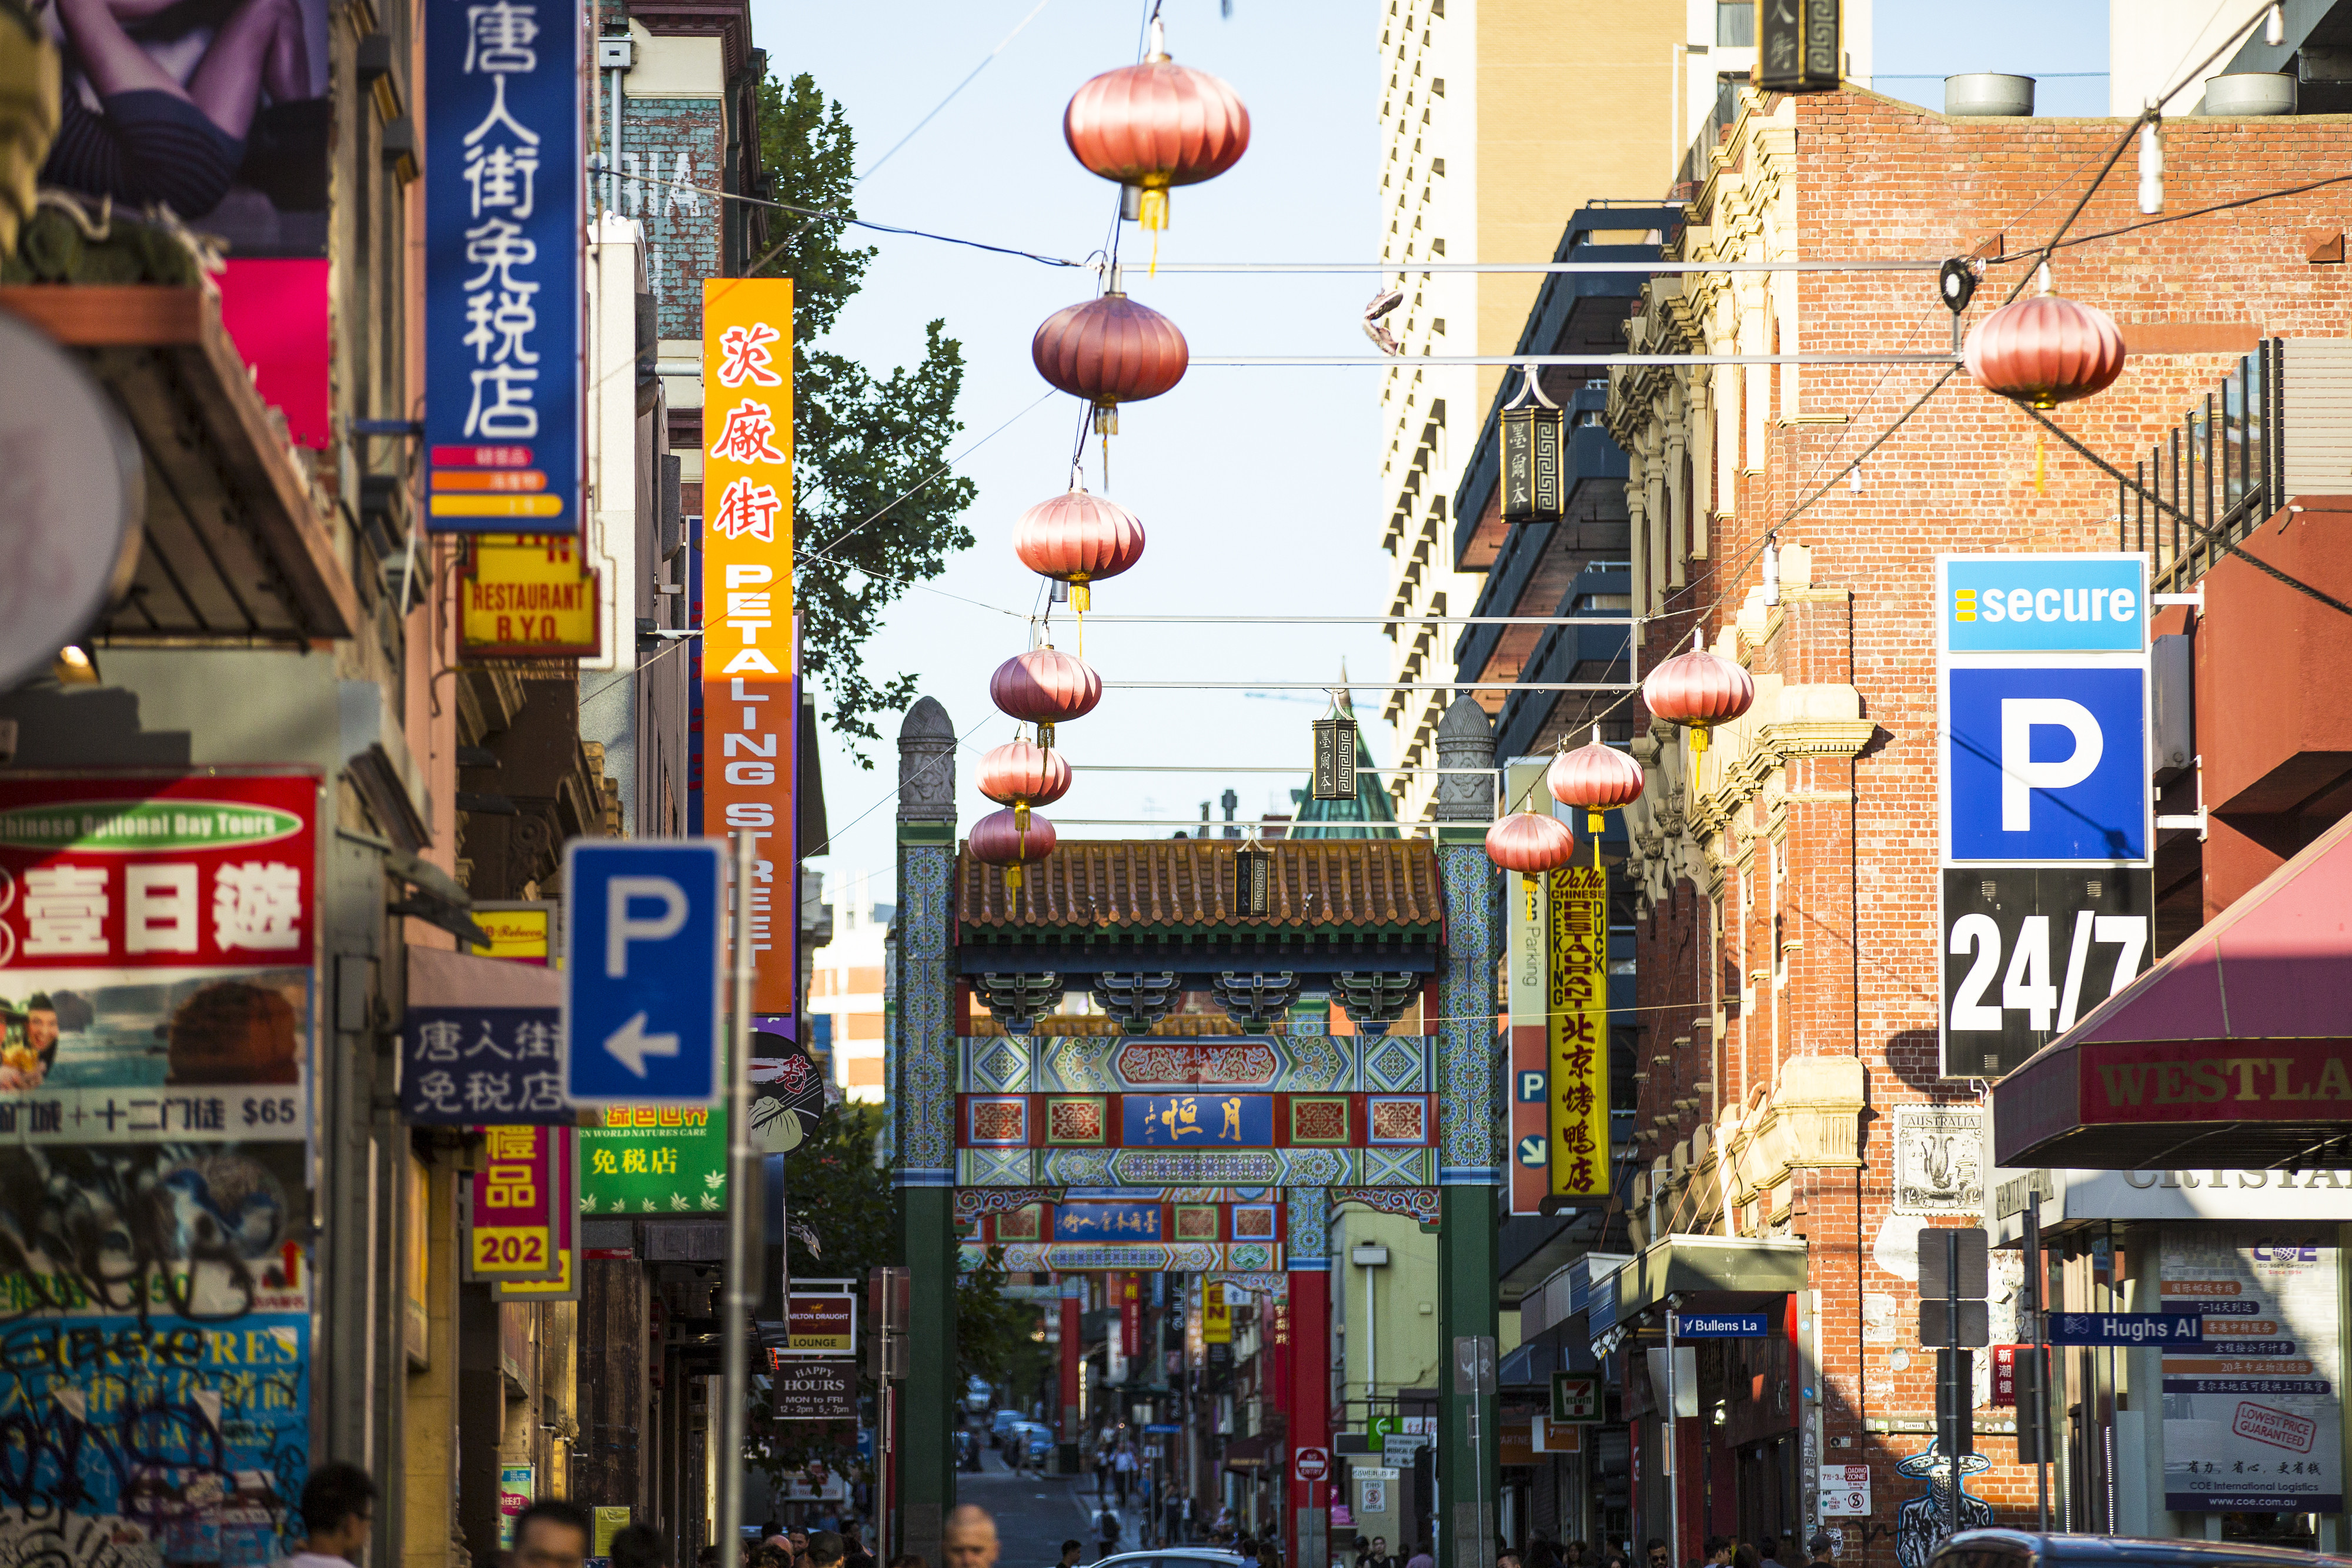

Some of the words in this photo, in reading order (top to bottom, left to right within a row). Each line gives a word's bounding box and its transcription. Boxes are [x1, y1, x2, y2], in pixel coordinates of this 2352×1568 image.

[463, 1, 540, 438] 唐人街免税店
[711, 323, 786, 543] 茨廠街
[1510, 423, 1528, 509] 墨爾本
[472, 583, 583, 610] RESTAURANT
[1982, 587, 2135, 622] secure
[722, 565, 779, 785] PETALING
[1319, 730, 1331, 790] 墨爾本
[2001, 698, 2104, 831] P
[82, 814, 169, 837] Optional
[175, 813, 212, 837] Day
[218, 813, 275, 835] Tours
[725, 803, 774, 967] STREET
[1551, 867, 1582, 888] Da
[1551, 890, 1605, 899] CHINESE
[23, 861, 300, 957] 壹日遊
[606, 876, 689, 978] P
[1522, 927, 1541, 987] Parking
[1552, 901, 1563, 1006] PEKING
[1593, 901, 1604, 974] DUCK
[1564, 901, 1591, 1009] RESTAURANT
[1949, 910, 2148, 1034] 24/7
[413, 1070, 561, 1112] 免税店
[1524, 1073, 1544, 1100] P
[242, 1097, 295, 1126] $65
[1907, 1117, 1976, 1126] AUSTRALIA
[594, 1129, 630, 1138] WORLD
[632, 1129, 678, 1137] NATURES
[679, 1128, 706, 1136] CARE
[592, 1147, 677, 1174] 免税店
[2123, 1170, 2352, 1188] CRYSTA
[481, 1236, 542, 1263] 202
[2171, 1283, 2235, 1293] 国际邮政专线
[2199, 1303, 2252, 1313] 7-14天到达
[1696, 1319, 1739, 1331] Bullens
[1743, 1319, 1757, 1331] La
[2103, 1318, 2168, 1342] Hughs
[2208, 1322, 2271, 1333] 香港中转服务
[794, 1339, 837, 1347] LOUNGE
[2214, 1342, 2288, 1353] 全程按公斤计费
[795, 1366, 834, 1379] HAPPY
[2221, 1362, 2307, 1372] 20年专业物流经验
[784, 1379, 845, 1391] HOURS
[2196, 1381, 2323, 1393] 墨尔本地区可提供上门取货
[796, 1405, 813, 1415] 2pm
[833, 1405, 849, 1415] 7pm
[2241, 1407, 2281, 1426] LOWEST
[2282, 1419, 2310, 1435] PRICE
[2240, 1420, 2305, 1447] GUARANTEED
[2190, 1482, 2211, 1490] COE
[2214, 1482, 2275, 1490] International
[2278, 1482, 2318, 1493] Logistics
[2209, 1498, 2297, 1506] www.coe.com.au
